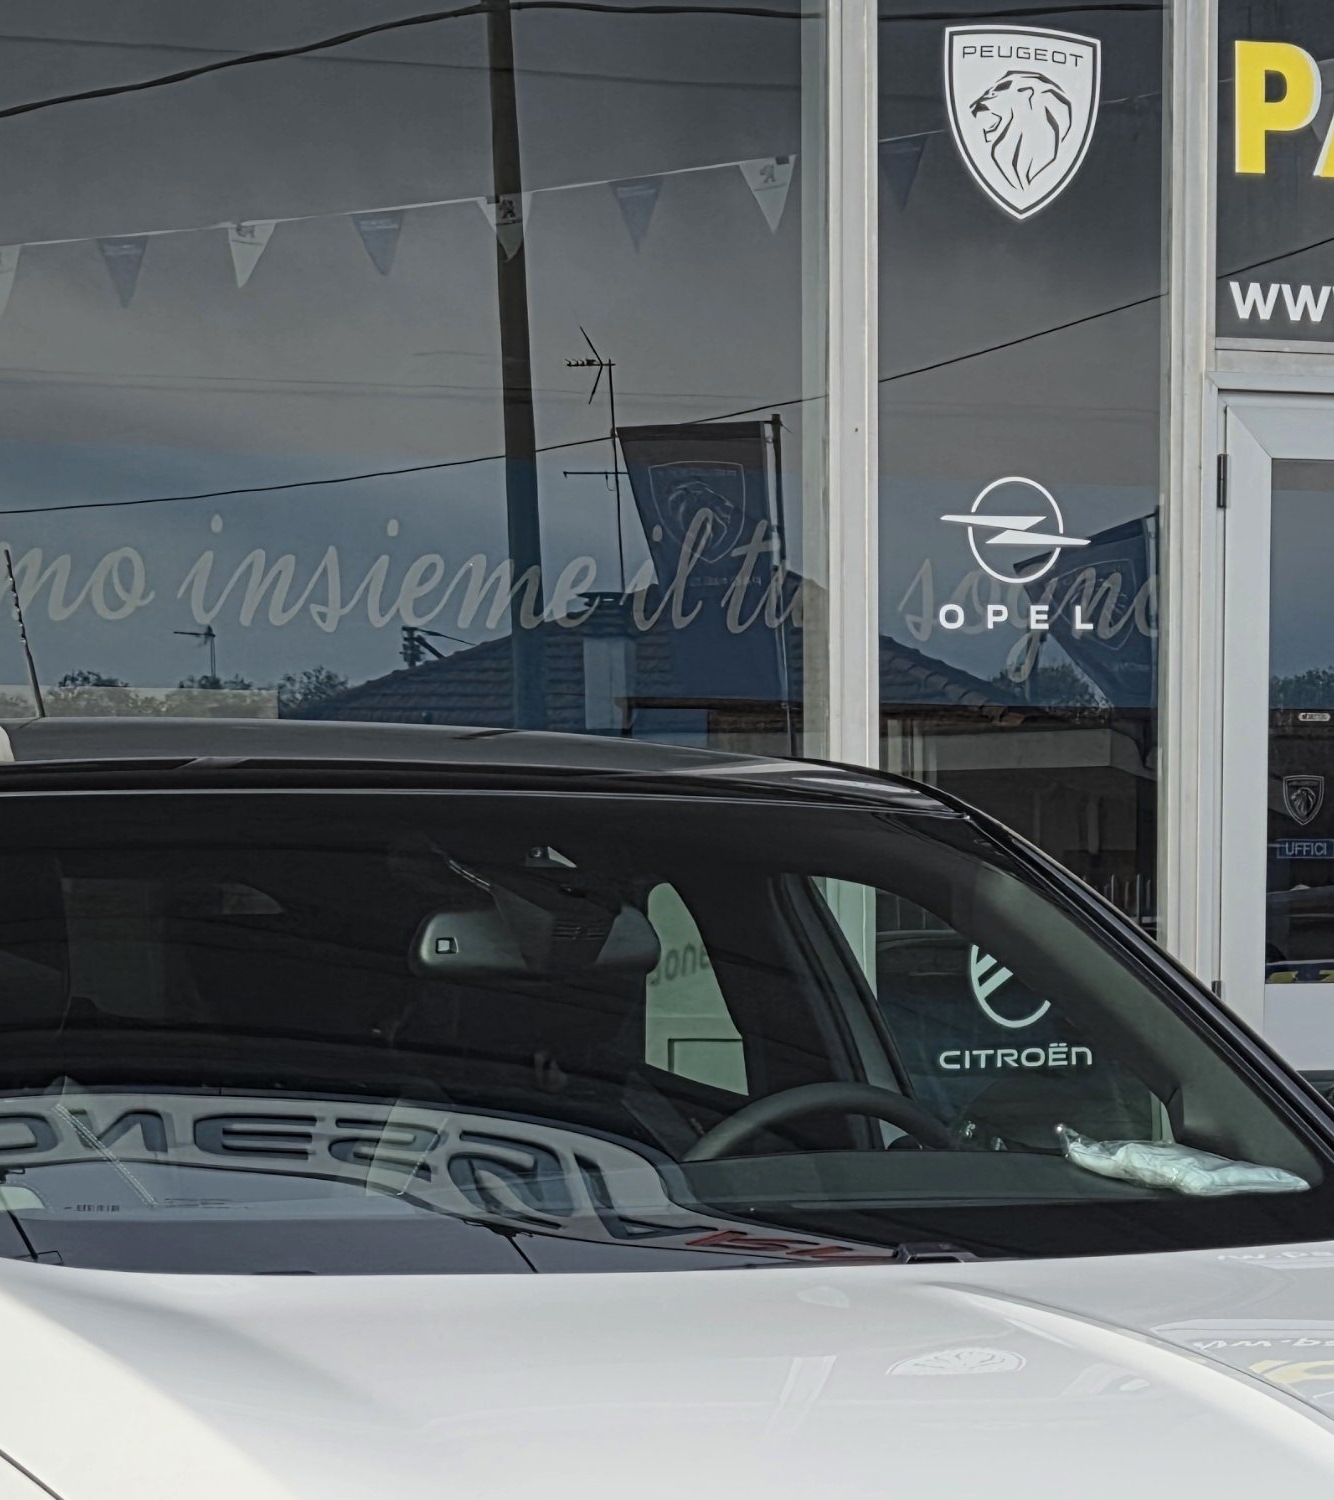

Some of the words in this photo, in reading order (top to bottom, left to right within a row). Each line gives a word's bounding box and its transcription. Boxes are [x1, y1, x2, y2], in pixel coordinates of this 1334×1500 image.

[961, 43, 1085, 68] PEUGEOT
[173, 513, 601, 633] insieme
[619, 507, 703, 632] il
[938, 603, 1095, 631] OPEL
[1284, 842, 1328, 856] UFFICI
